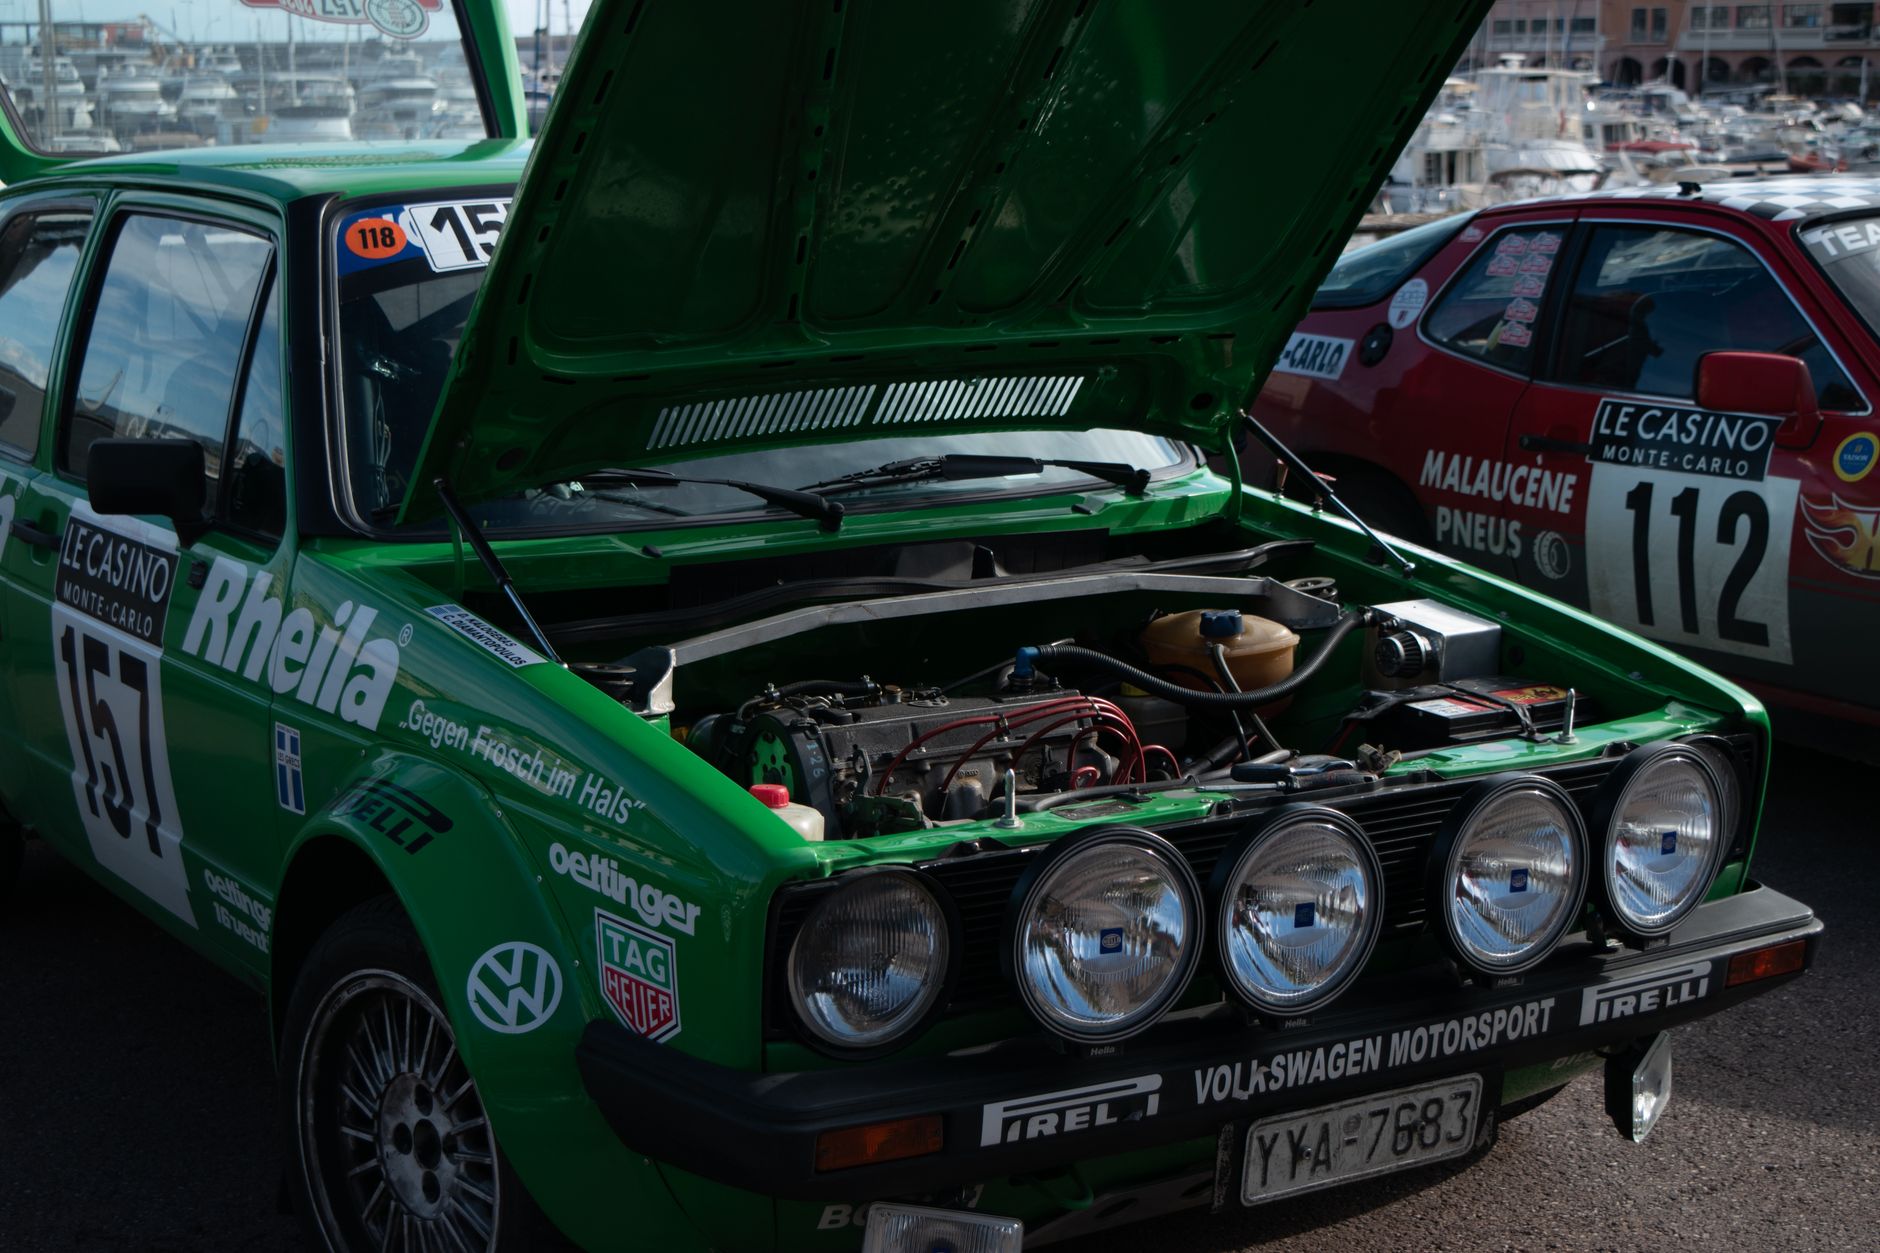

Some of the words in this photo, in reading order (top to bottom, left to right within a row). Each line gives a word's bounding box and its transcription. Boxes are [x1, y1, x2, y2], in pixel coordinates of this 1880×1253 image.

[358, 227, 396, 249] 118
[430, 203, 511, 262] 15
[1598, 404, 1636, 437] LE
[1637, 409, 1769, 452] CASINO
[1419, 449, 1577, 514] MALAUCÈNE
[63, 523, 93, 570] LE
[86, 533, 170, 603] CASINO
[1436, 505, 1522, 559] PNEUS
[1626, 481, 1770, 648] 112
[182, 555, 400, 732] Rheila
[61, 624, 163, 859] 157
[471, 724, 545, 784] Frosch
[546, 758, 577, 799] im
[549, 842, 700, 937] oettinger
[605, 928, 666, 983] TAG
[607, 970, 672, 1034] HEUER
[1578, 960, 1712, 1026] PIRELLI
[1195, 1034, 1383, 1104] VOLKSWAGEN
[1388, 997, 1555, 1068] MOTORSPORT
